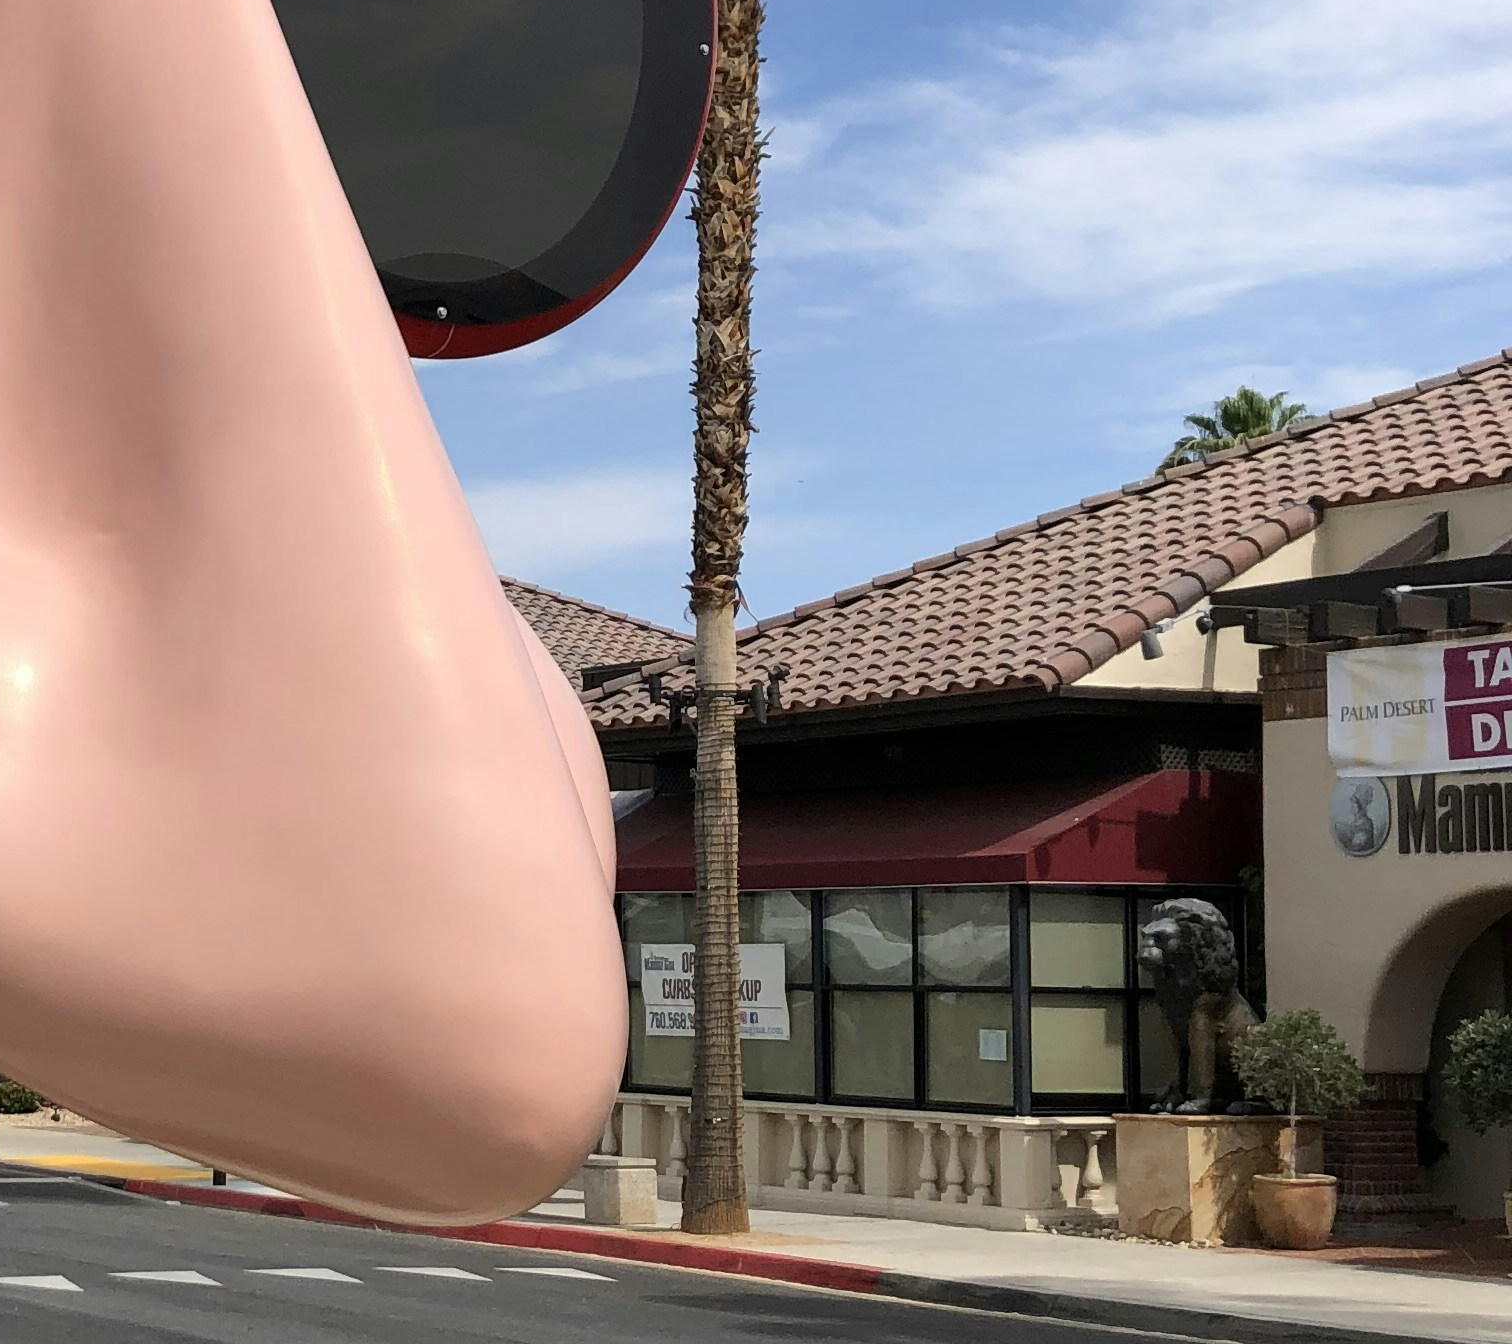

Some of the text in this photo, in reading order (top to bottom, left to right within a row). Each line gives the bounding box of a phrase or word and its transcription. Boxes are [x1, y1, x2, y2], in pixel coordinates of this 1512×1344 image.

[1340, 697, 1436, 723] PALM DESERT
[1396, 775, 1512, 855] Mam
